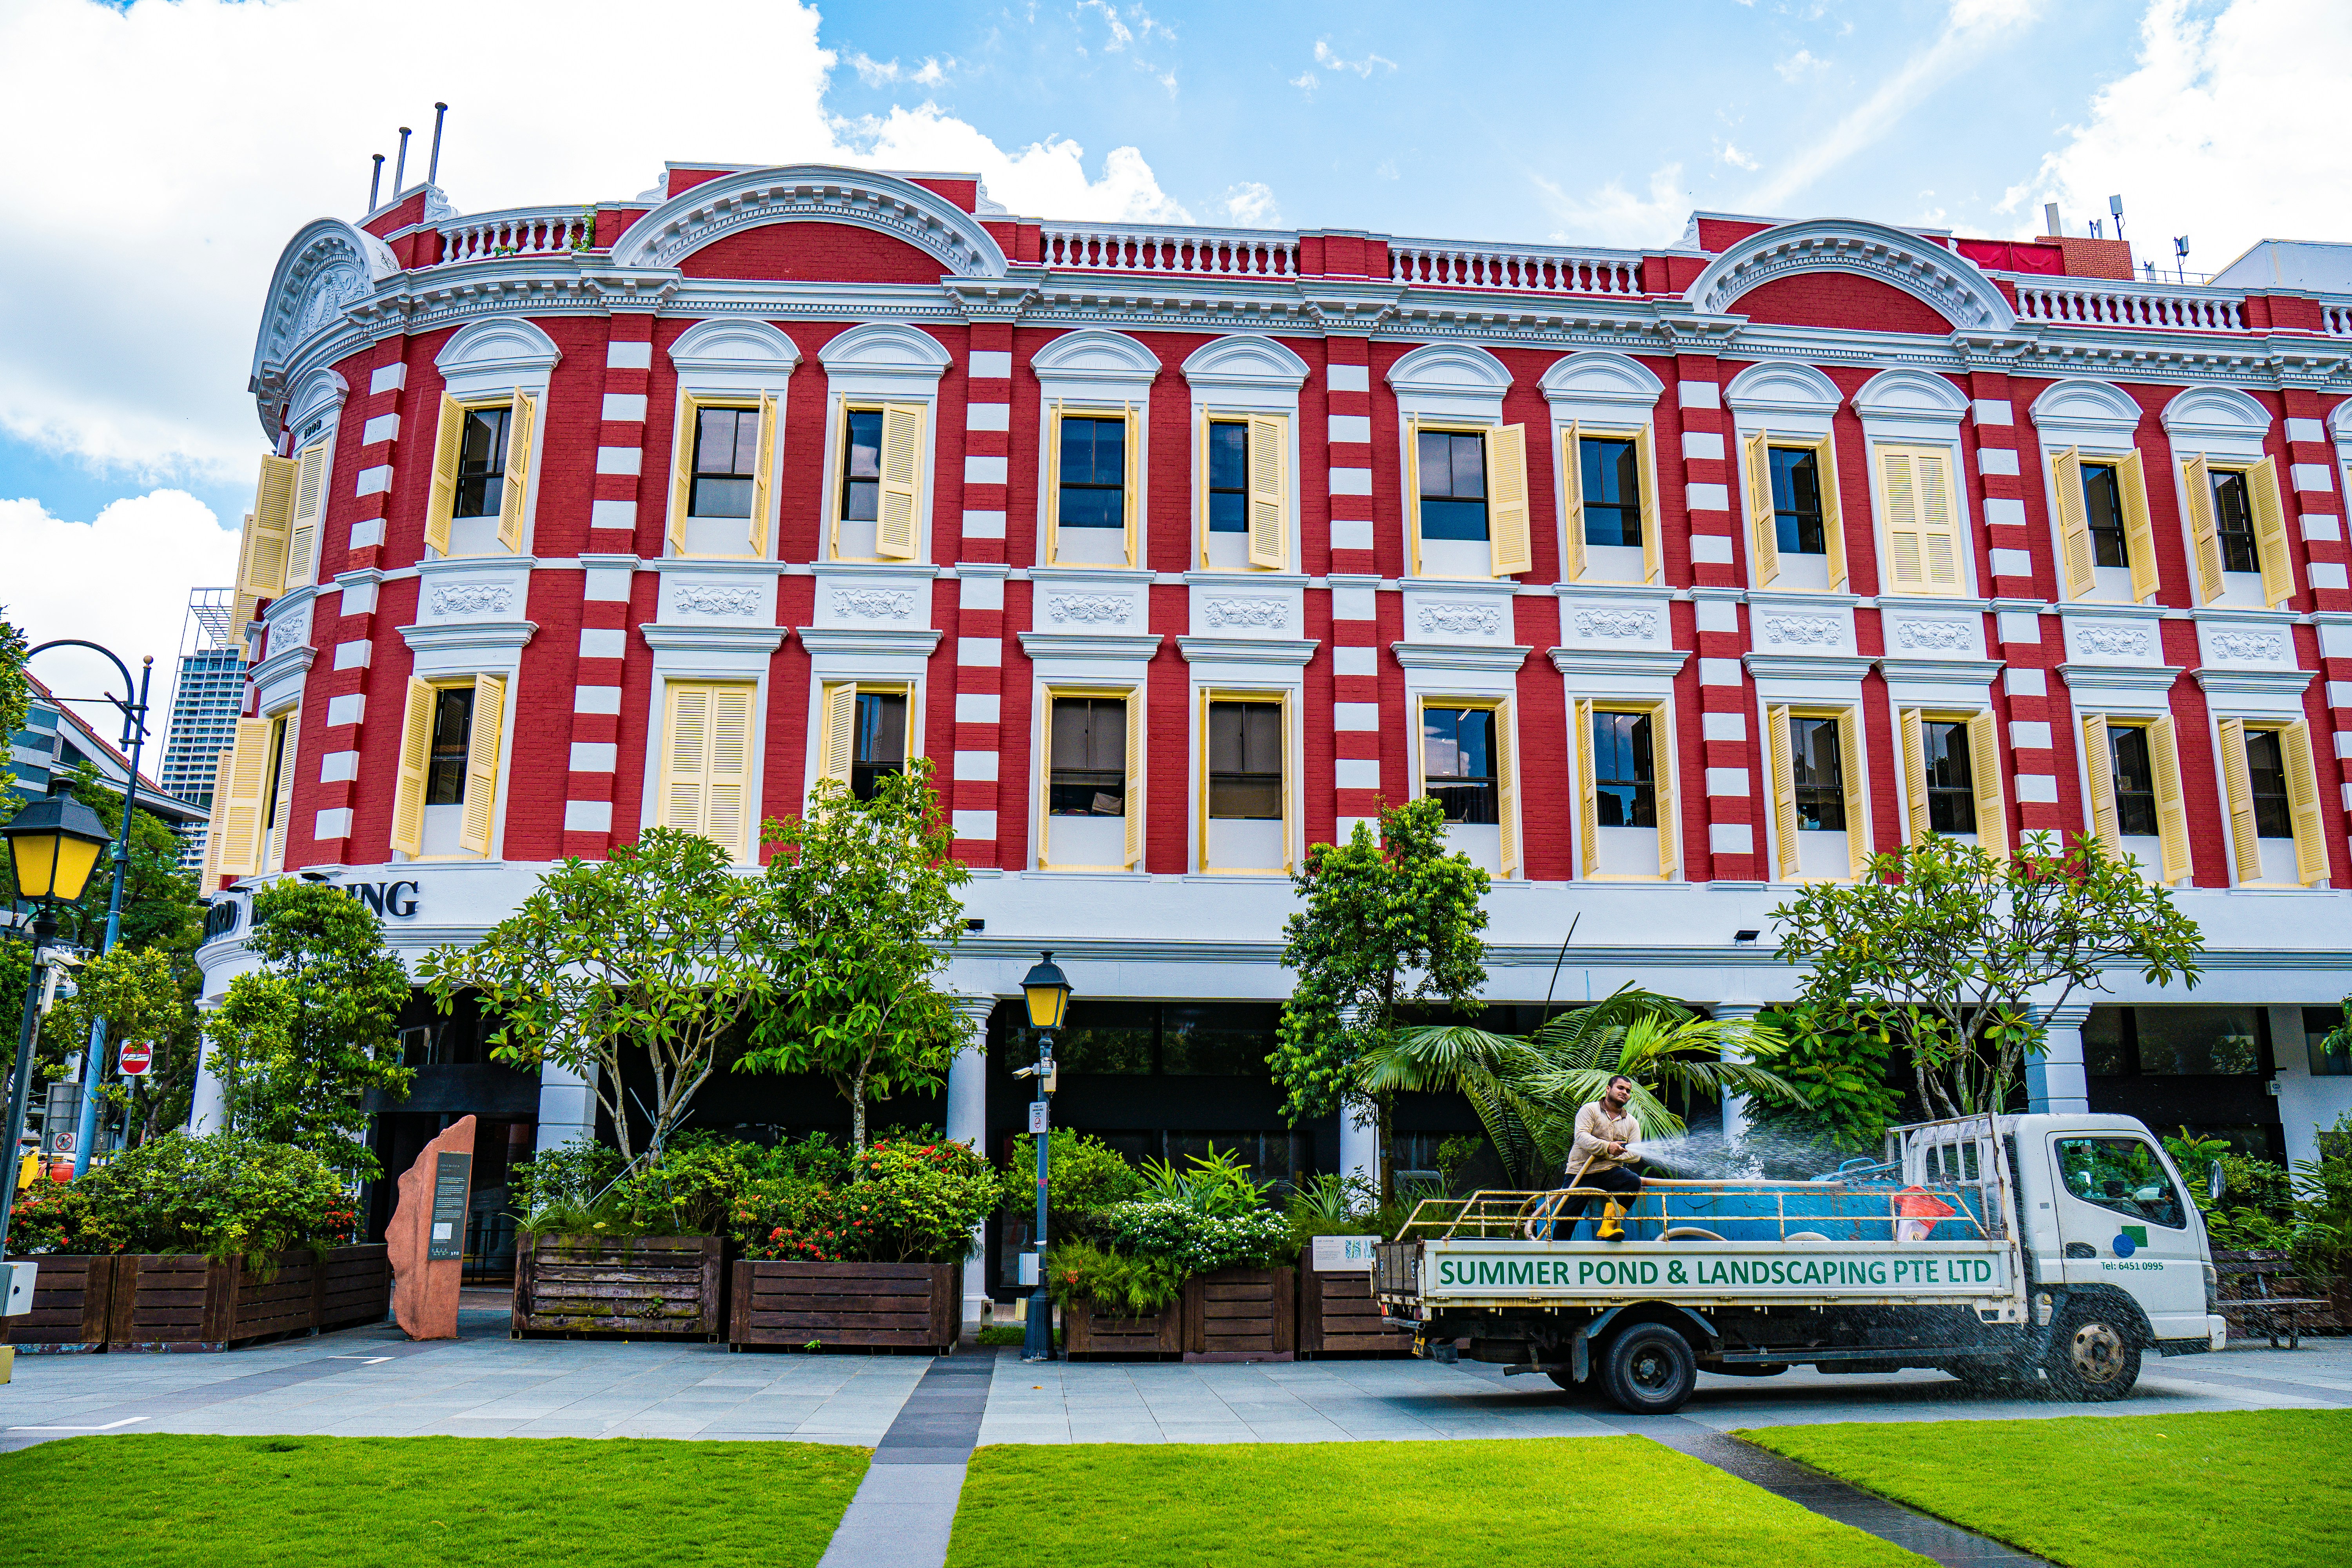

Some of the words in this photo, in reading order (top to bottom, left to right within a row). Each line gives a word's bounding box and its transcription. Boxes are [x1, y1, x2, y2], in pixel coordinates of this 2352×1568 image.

[304, 419, 321, 439] 1903
[1440, 1261, 1570, 1285] SUMMER
[1579, 1261, 1659, 1284] POND
[1667, 1260, 1689, 1284] &
[1697, 1260, 1886, 1285] LANDSCAPING
[1894, 1260, 1939, 1283] PTE
[1948, 1259, 1991, 1283] LTD
[2101, 1261, 2116, 1270] Tel:
[2119, 1262, 2140, 1270] 6451
[2142, 1262, 2163, 1270] 0995
